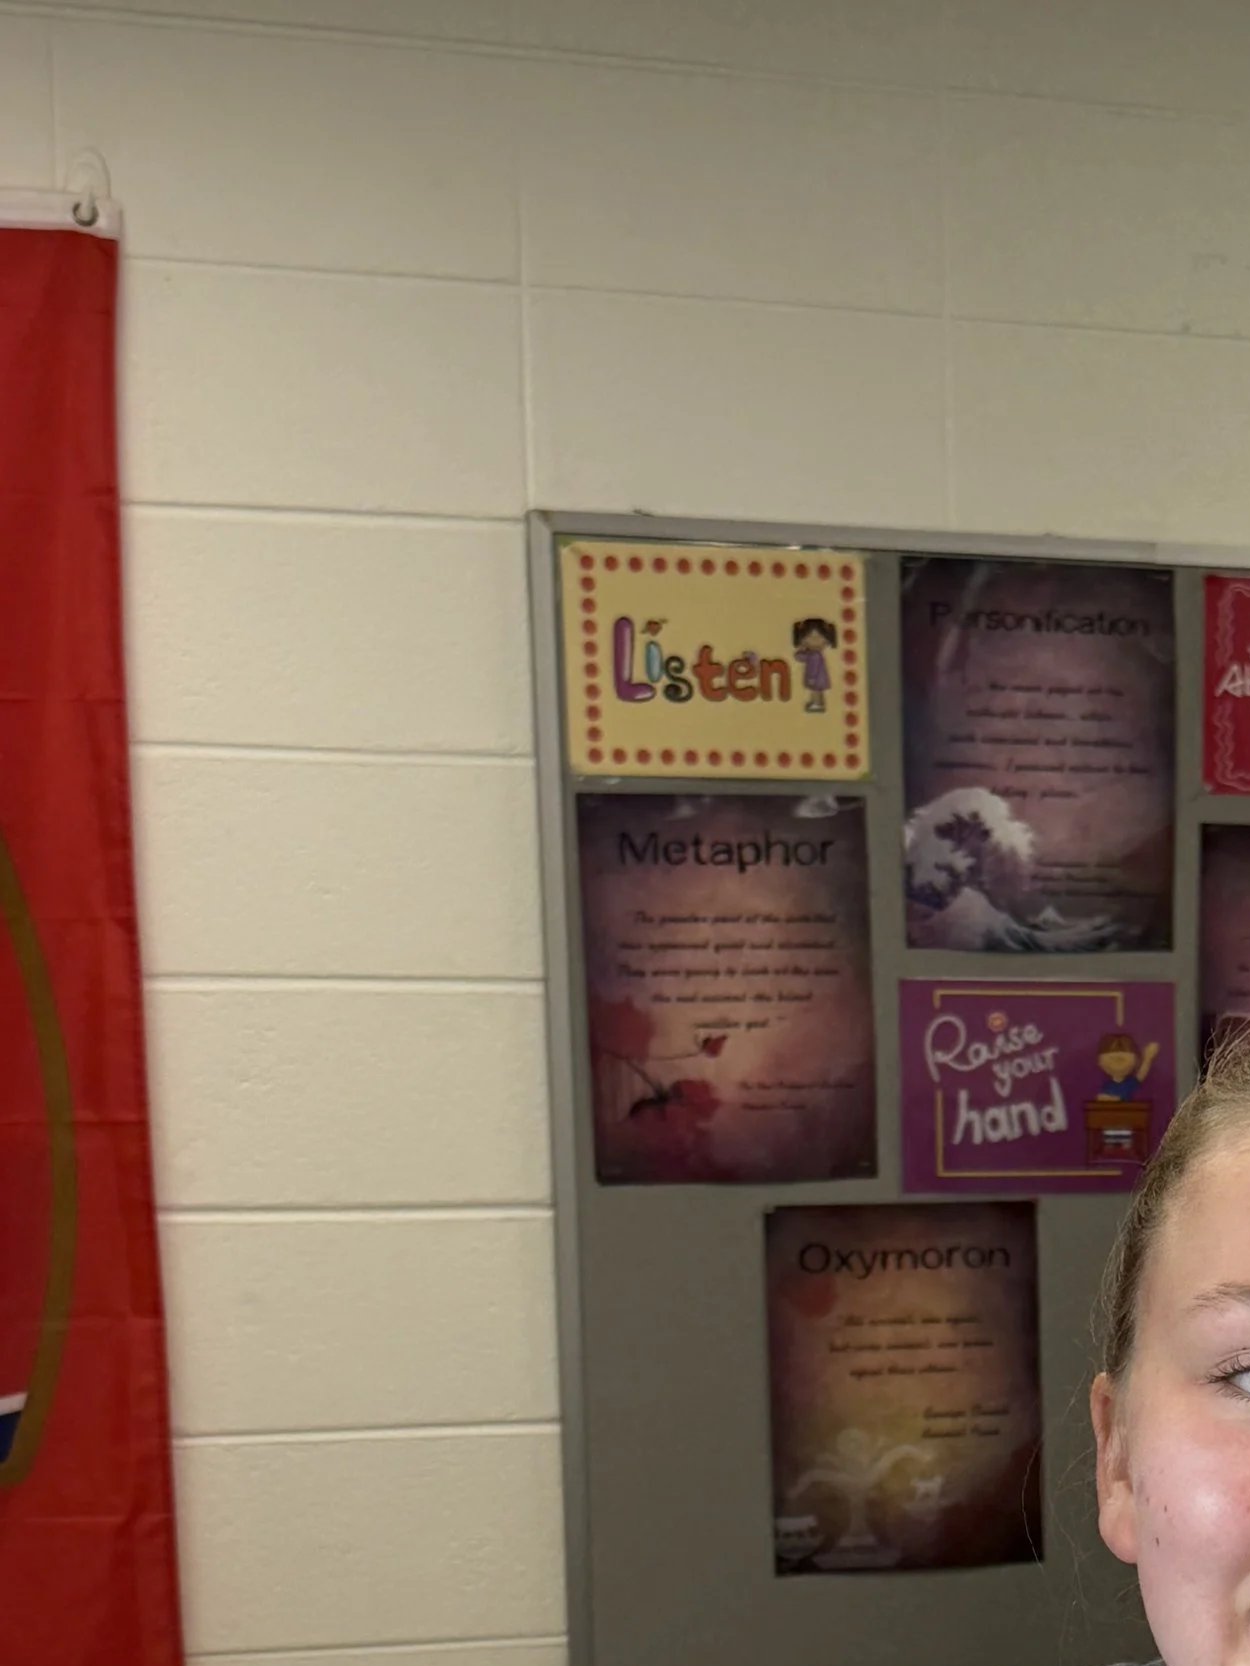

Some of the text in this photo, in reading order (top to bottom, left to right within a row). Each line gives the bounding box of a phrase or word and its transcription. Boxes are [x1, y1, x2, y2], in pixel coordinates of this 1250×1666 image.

[930, 600, 1151, 638] Personification
[611, 615, 791, 703] Listen
[617, 831, 834, 876] Metaphor
[925, 1013, 1044, 1082] Raise
[992, 1047, 1060, 1097] your
[951, 1081, 1068, 1146] hand
[798, 1241, 1012, 1281] Oxymoron
